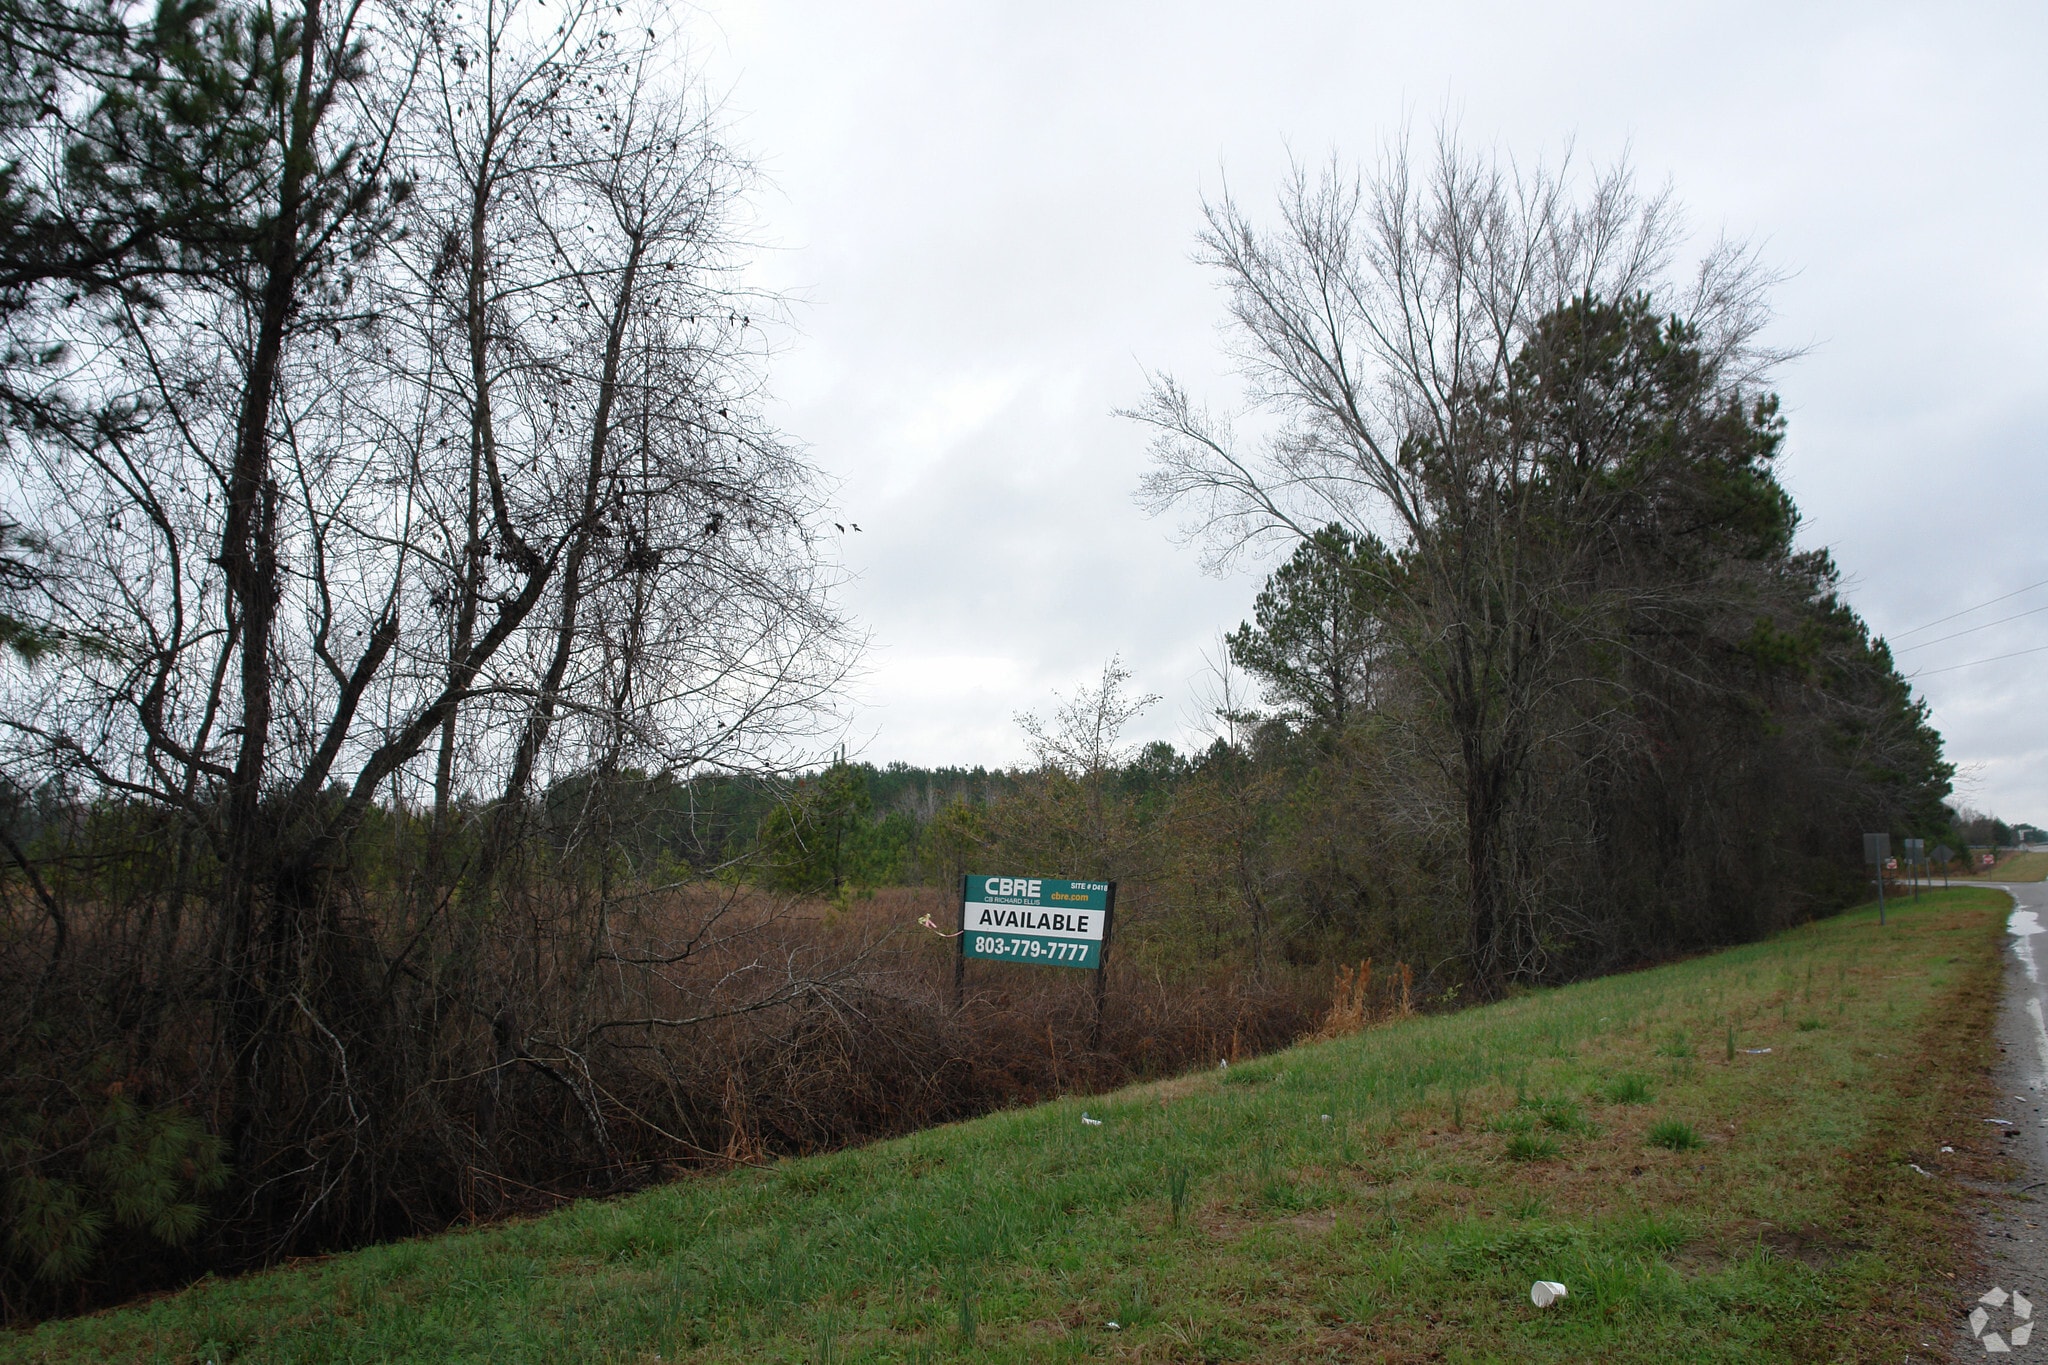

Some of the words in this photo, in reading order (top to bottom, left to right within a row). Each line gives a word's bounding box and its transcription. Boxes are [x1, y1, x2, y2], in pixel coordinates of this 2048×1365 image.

[985, 877, 1042, 898] CBRE
[1071, 882, 1086, 890] SITE
[994, 897, 1022, 905] RICHARD
[1051, 892, 1089, 901] cbre.com
[979, 909, 1089, 933] AVAILABLE
[975, 936, 1089, 962] 803-779-7777
